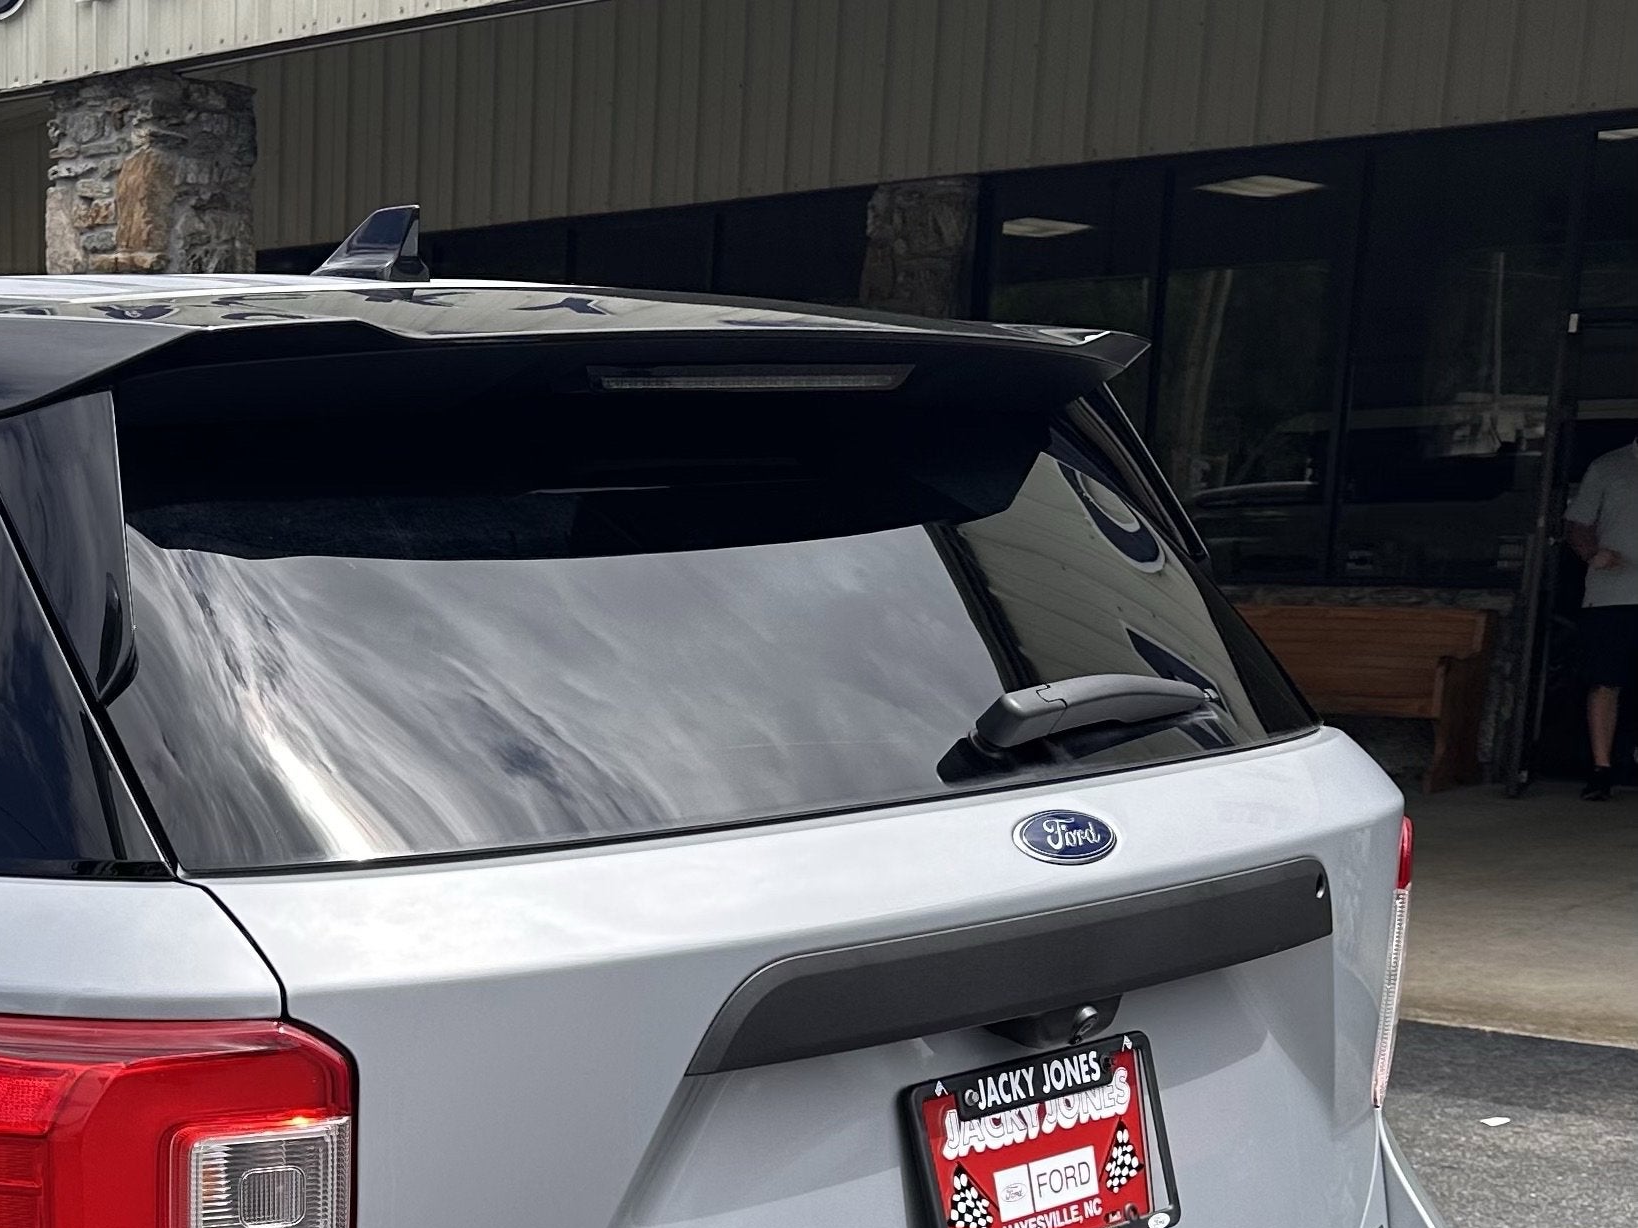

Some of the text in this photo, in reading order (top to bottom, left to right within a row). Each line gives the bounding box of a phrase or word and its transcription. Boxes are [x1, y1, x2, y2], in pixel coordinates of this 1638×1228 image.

[1042, 817, 1101, 851] Ford
[977, 1050, 1101, 1111] JACKY JONES
[942, 1066, 1131, 1161] JACKY JONES
[1036, 1161, 1091, 1199] FORD
[1083, 1198, 1103, 1219] NC
